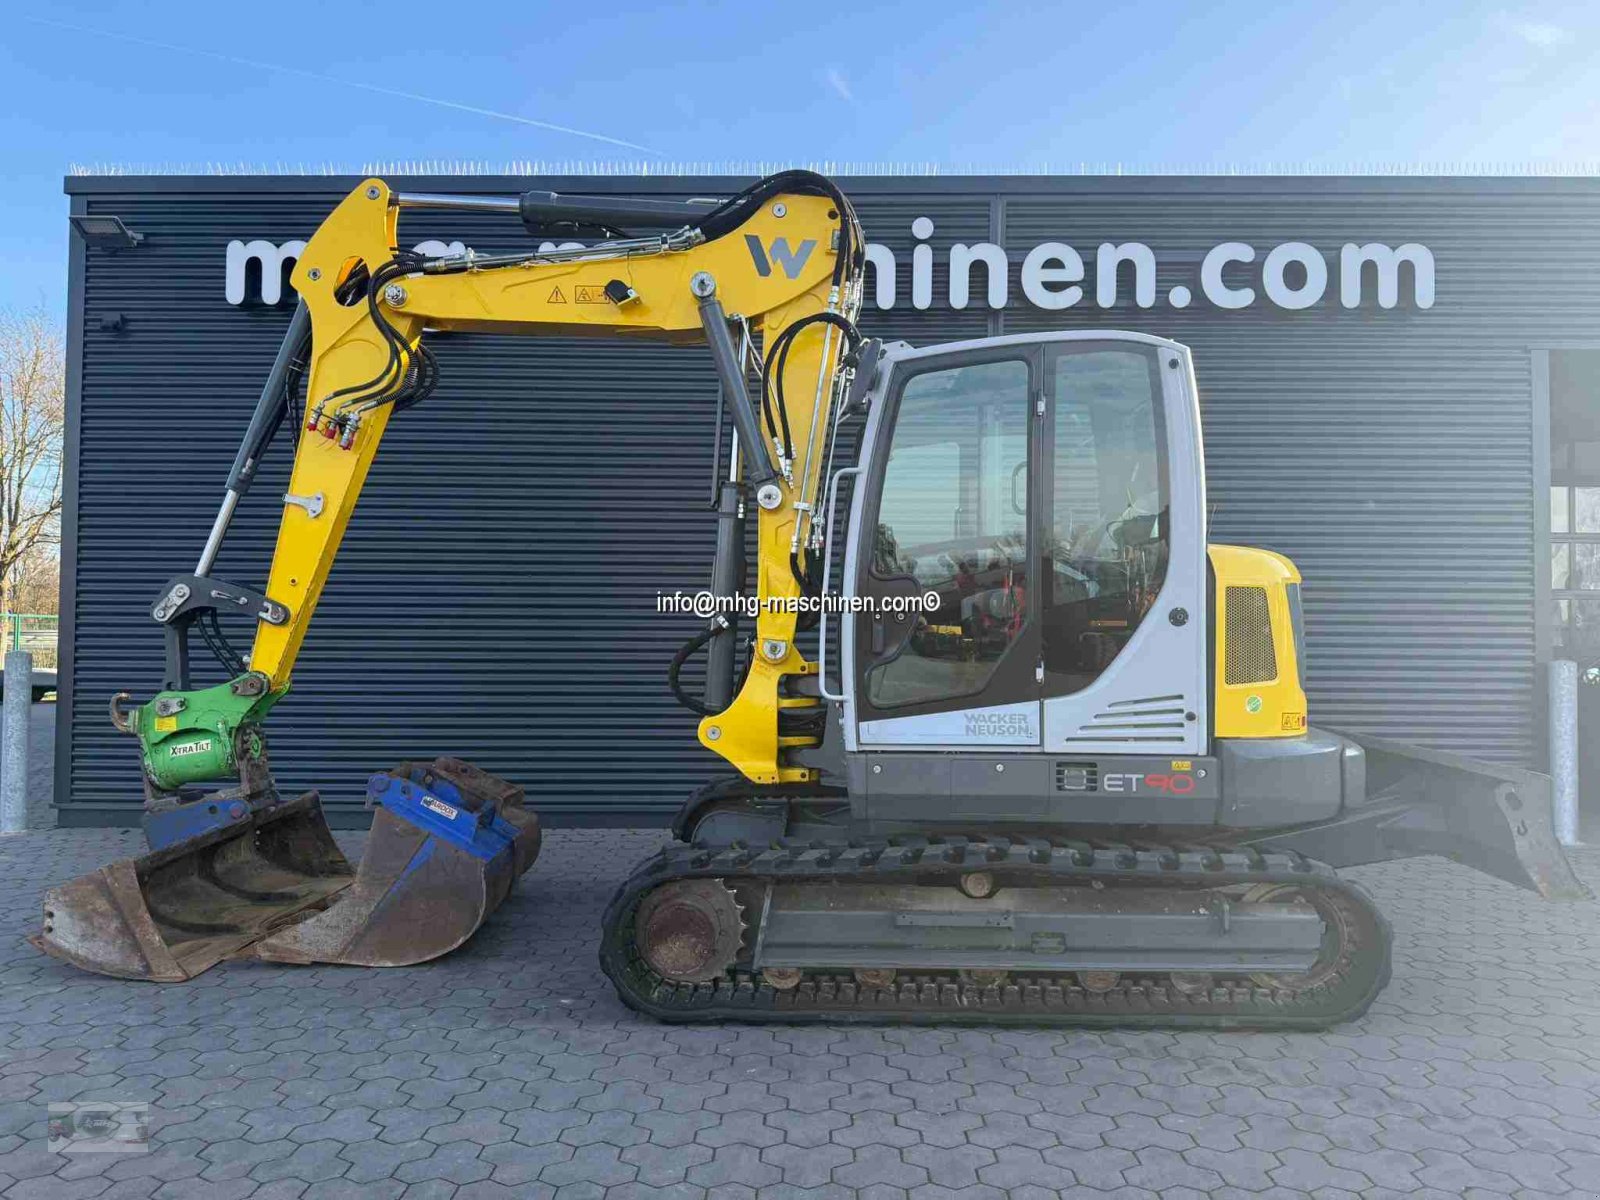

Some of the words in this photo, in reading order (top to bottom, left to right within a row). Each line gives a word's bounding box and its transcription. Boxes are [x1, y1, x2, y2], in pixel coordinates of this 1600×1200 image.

[964, 712, 1029, 725] WACKER
[965, 724, 1030, 737] NEUSON
[1103, 773, 1195, 794] ET90
